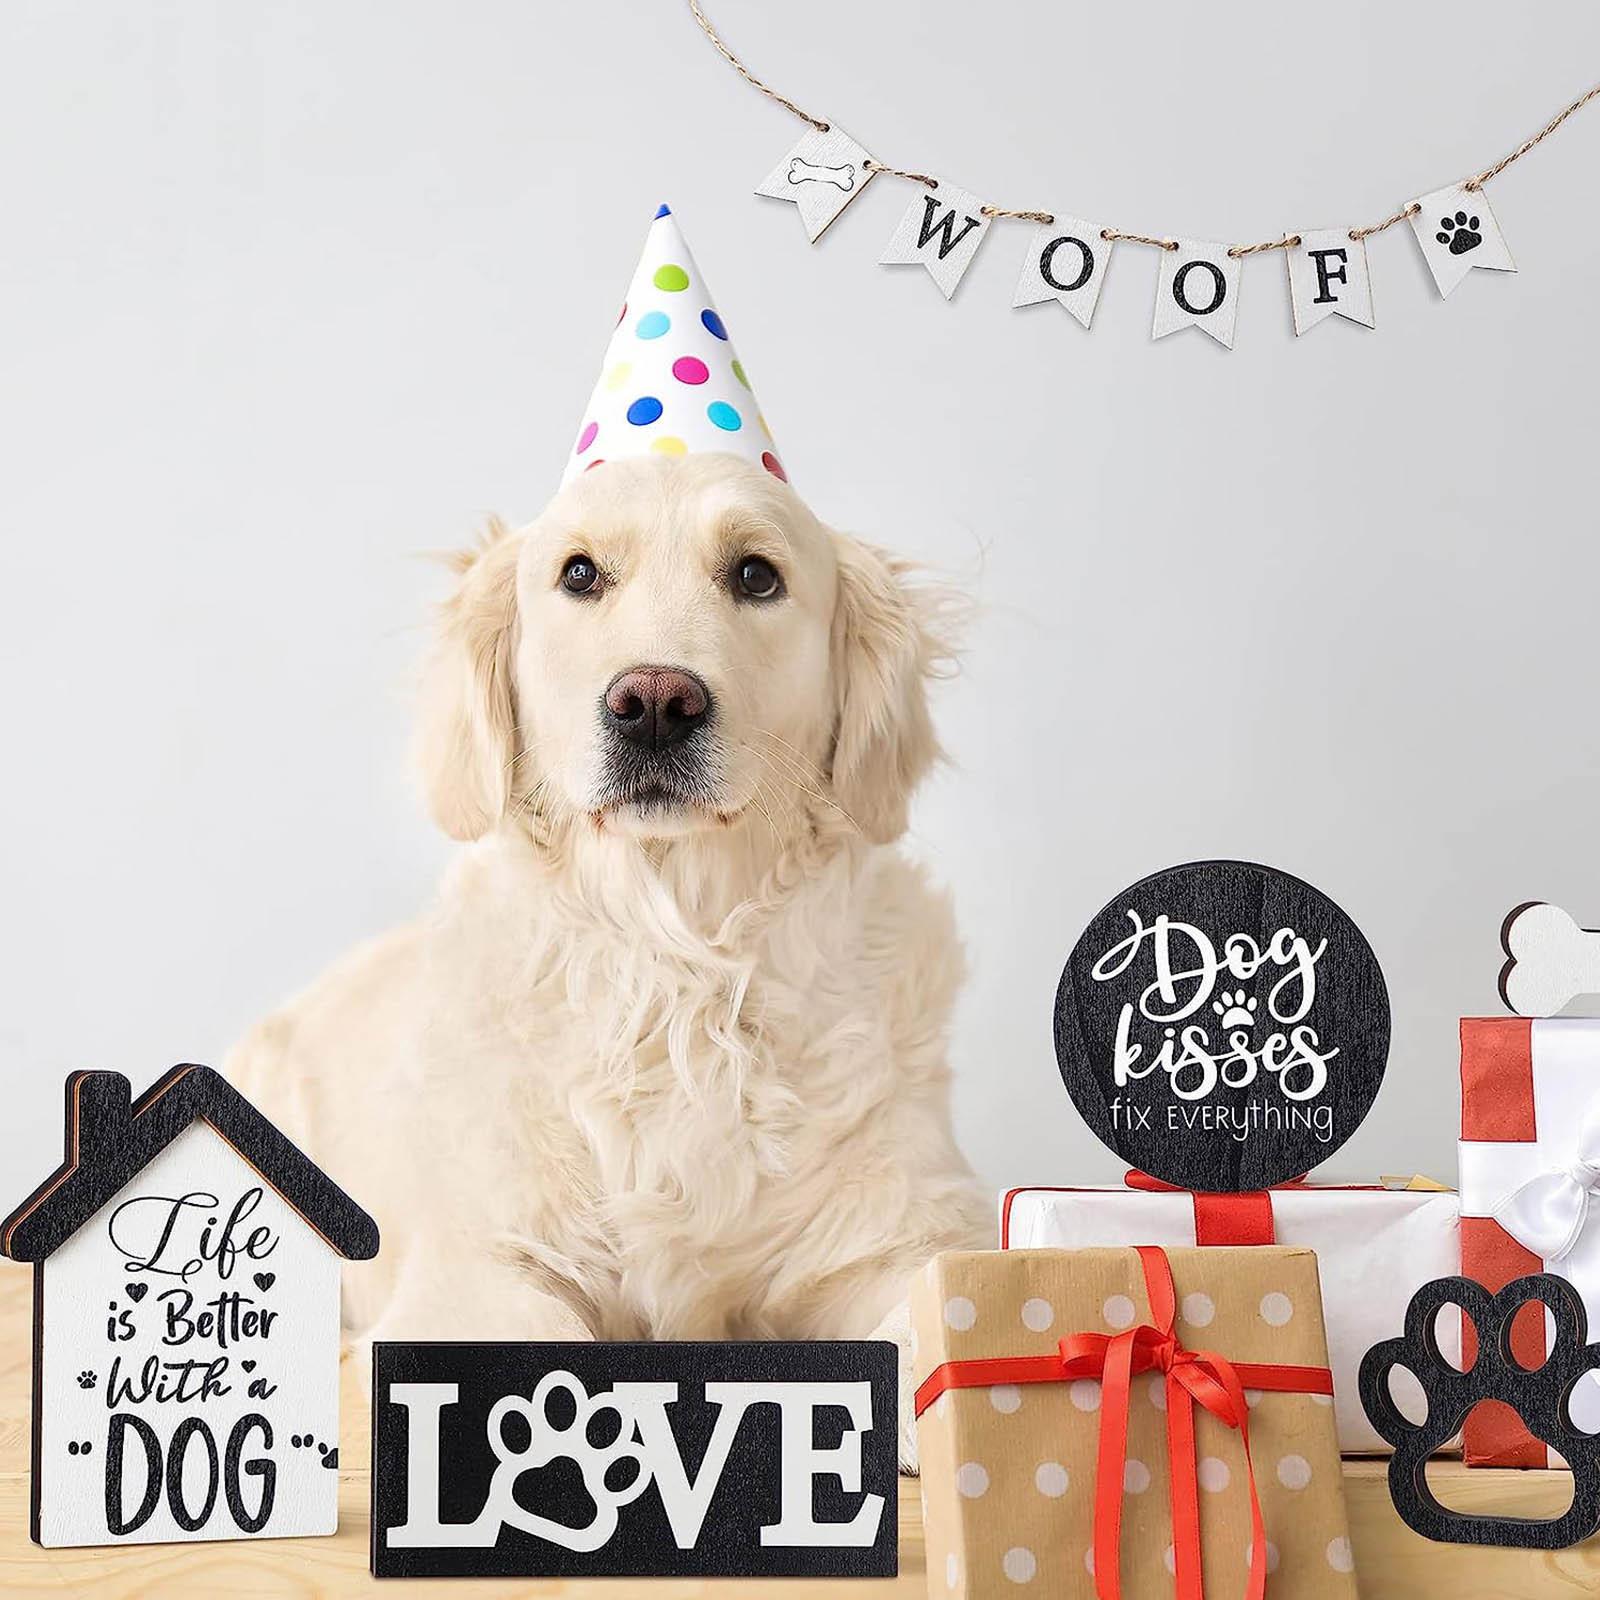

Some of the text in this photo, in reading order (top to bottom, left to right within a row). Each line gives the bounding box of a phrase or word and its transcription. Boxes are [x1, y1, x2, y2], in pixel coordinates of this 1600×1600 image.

[915, 194, 1349, 316] WOOF
[1091, 908, 1329, 1024] Dog
[1113, 1002, 1341, 1102] kisses
[1109, 1097, 1152, 1131] fix
[108, 1186, 280, 1284] Life
[106, 1288, 279, 1350] is Better
[105, 1354, 278, 1410] With a
[104, 1412, 277, 1536] DOG
